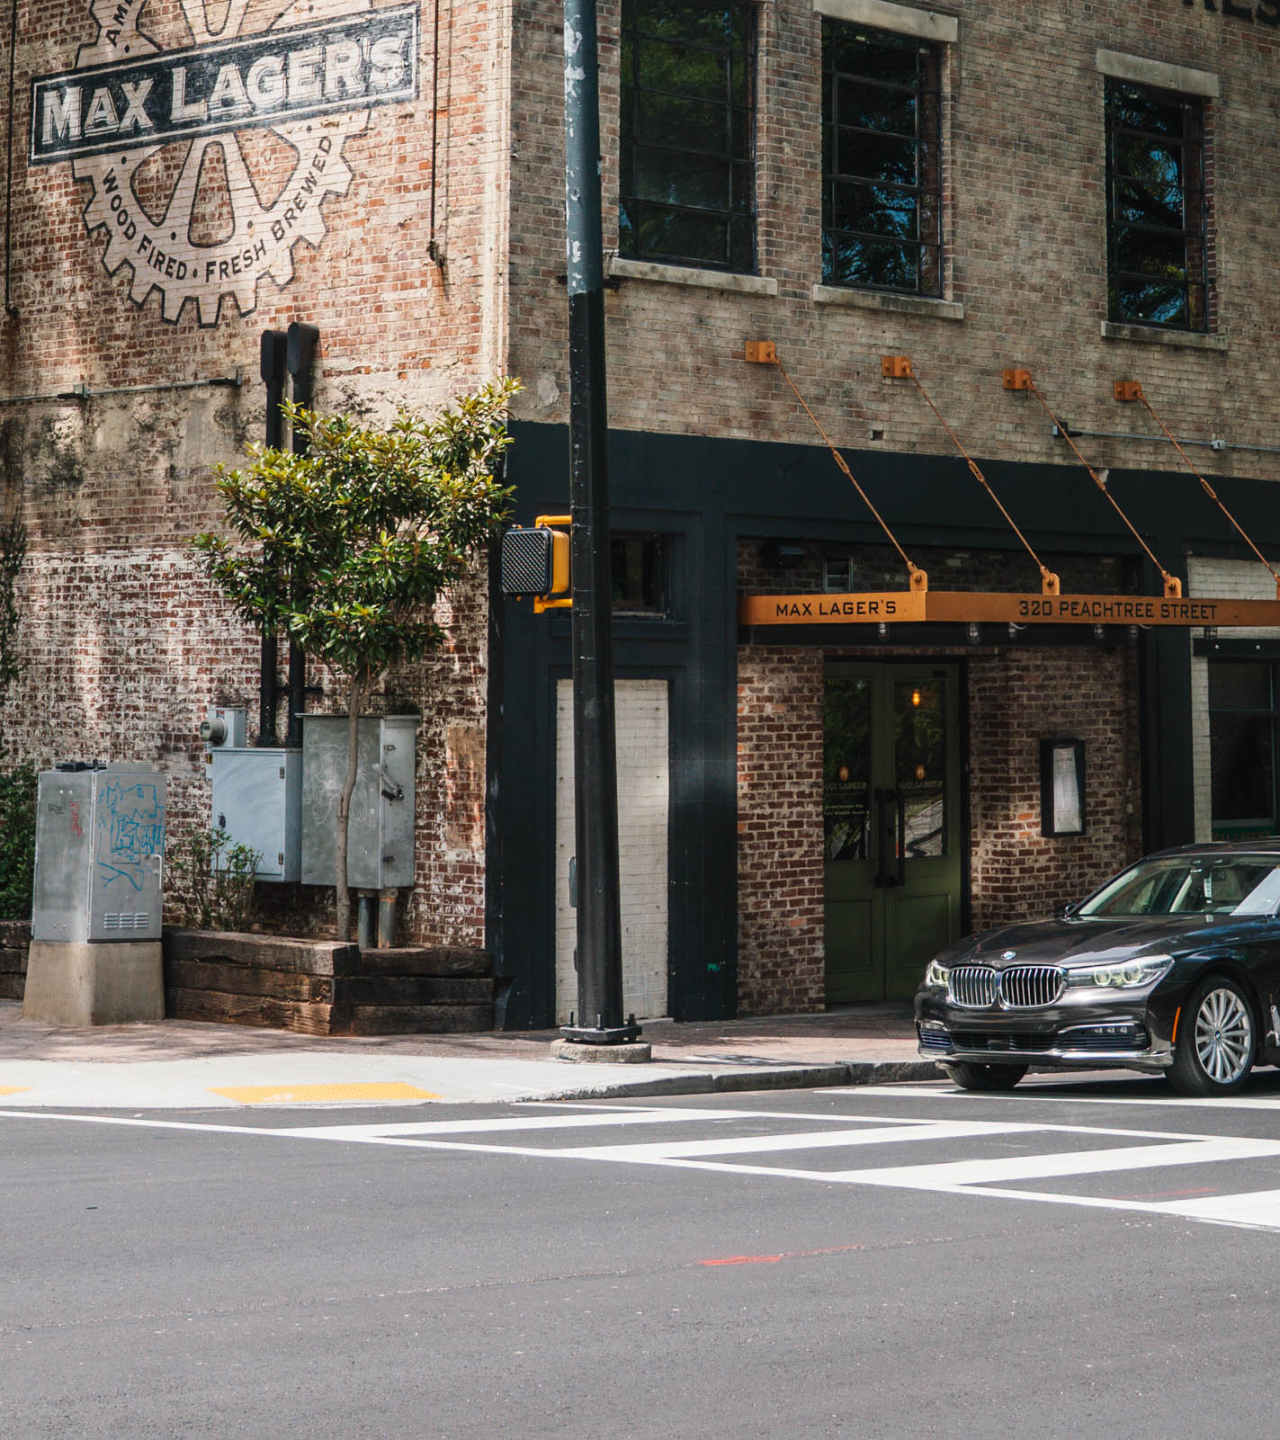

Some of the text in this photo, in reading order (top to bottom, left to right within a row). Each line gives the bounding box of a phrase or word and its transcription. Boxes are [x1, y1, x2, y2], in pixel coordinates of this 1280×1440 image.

[41, 78, 155, 146] MAX
[102, 135, 333, 283] WOOD FIRED FRESH BREWED
[776, 599, 897, 617] MAX LAGER'S
[1019, 602, 1218, 620] 320 PEACHTREE STREET
